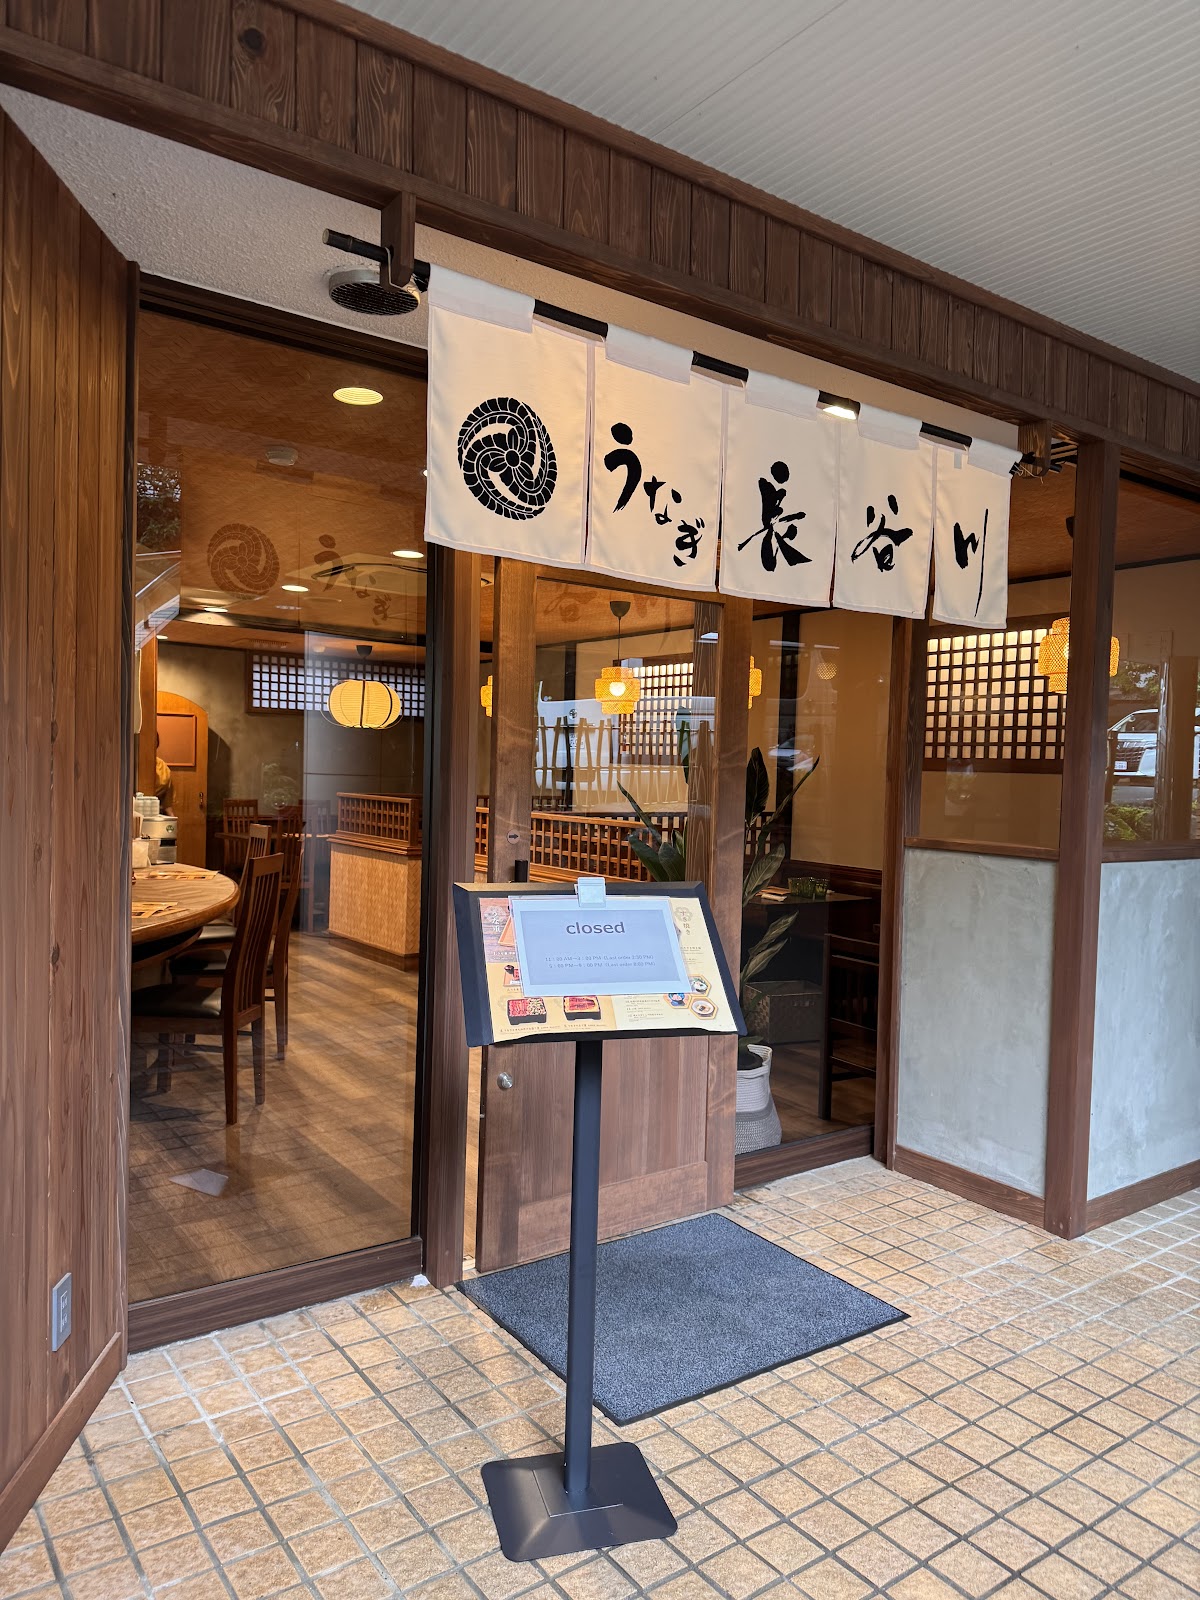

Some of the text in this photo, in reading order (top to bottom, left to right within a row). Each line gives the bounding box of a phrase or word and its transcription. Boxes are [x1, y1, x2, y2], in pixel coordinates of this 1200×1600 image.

[603, 423, 705, 568] うなぎ
[738, 461, 989, 618] 長谷川
[566, 921, 626, 935] closed
